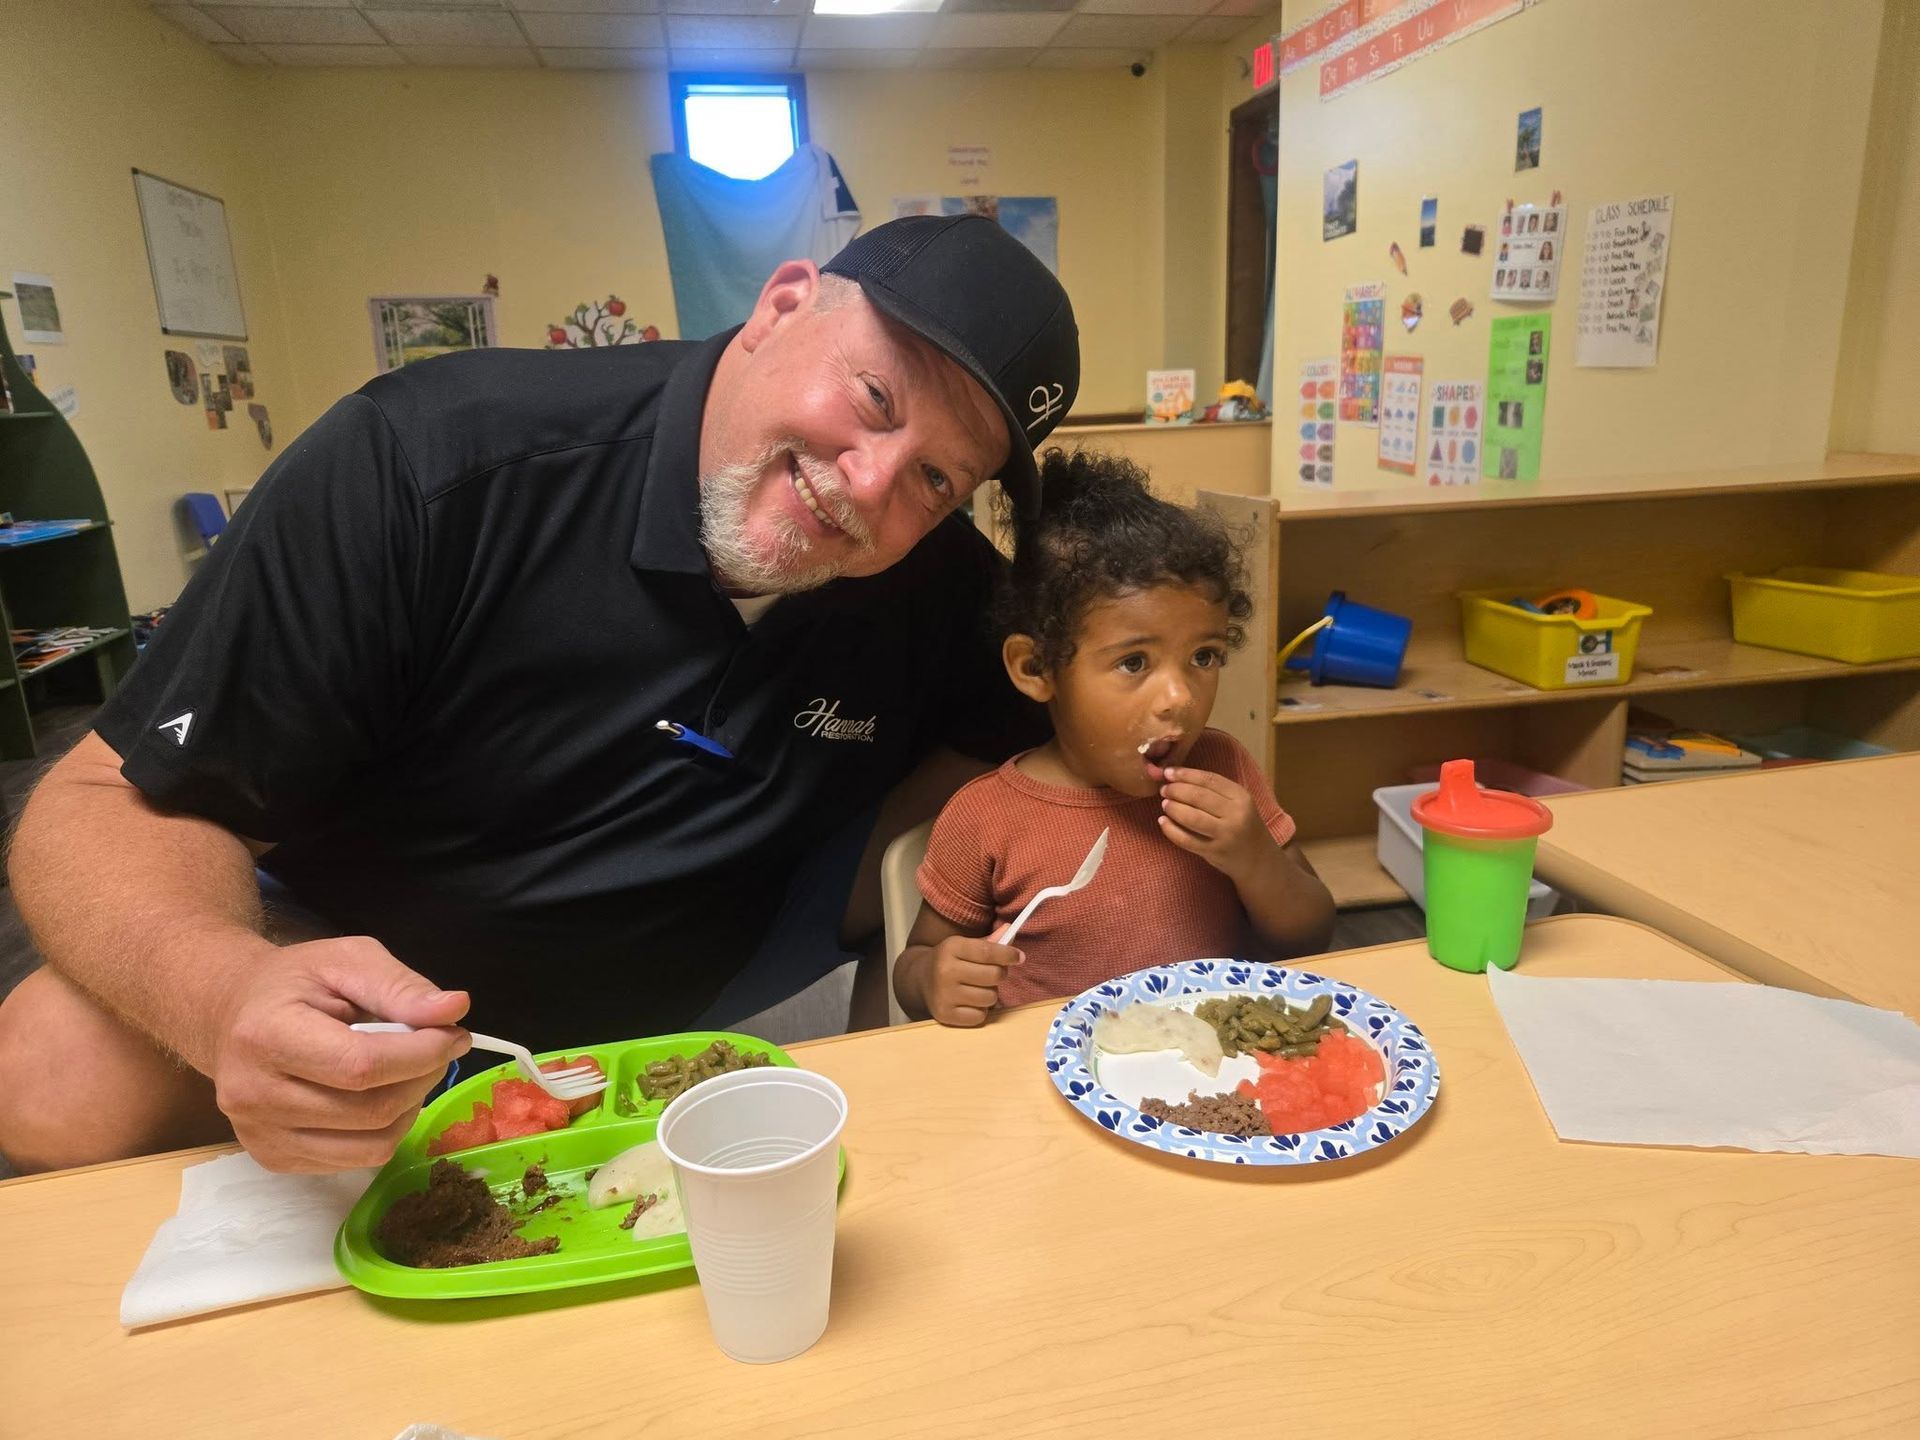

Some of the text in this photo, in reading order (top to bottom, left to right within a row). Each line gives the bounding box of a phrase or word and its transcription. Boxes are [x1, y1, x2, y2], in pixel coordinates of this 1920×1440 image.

[1322, 20, 1335, 39] Cc
[1369, 44, 1380, 66] Ss
[1392, 32, 1404, 53] Tt
[1417, 18, 1435, 41] Uu
[1595, 195, 1670, 224] CLASS SCHEDULE
[1436, 384, 1475, 401] SHAPES
[794, 698, 877, 736] Hannah
[820, 730, 874, 742] RESTORATION
